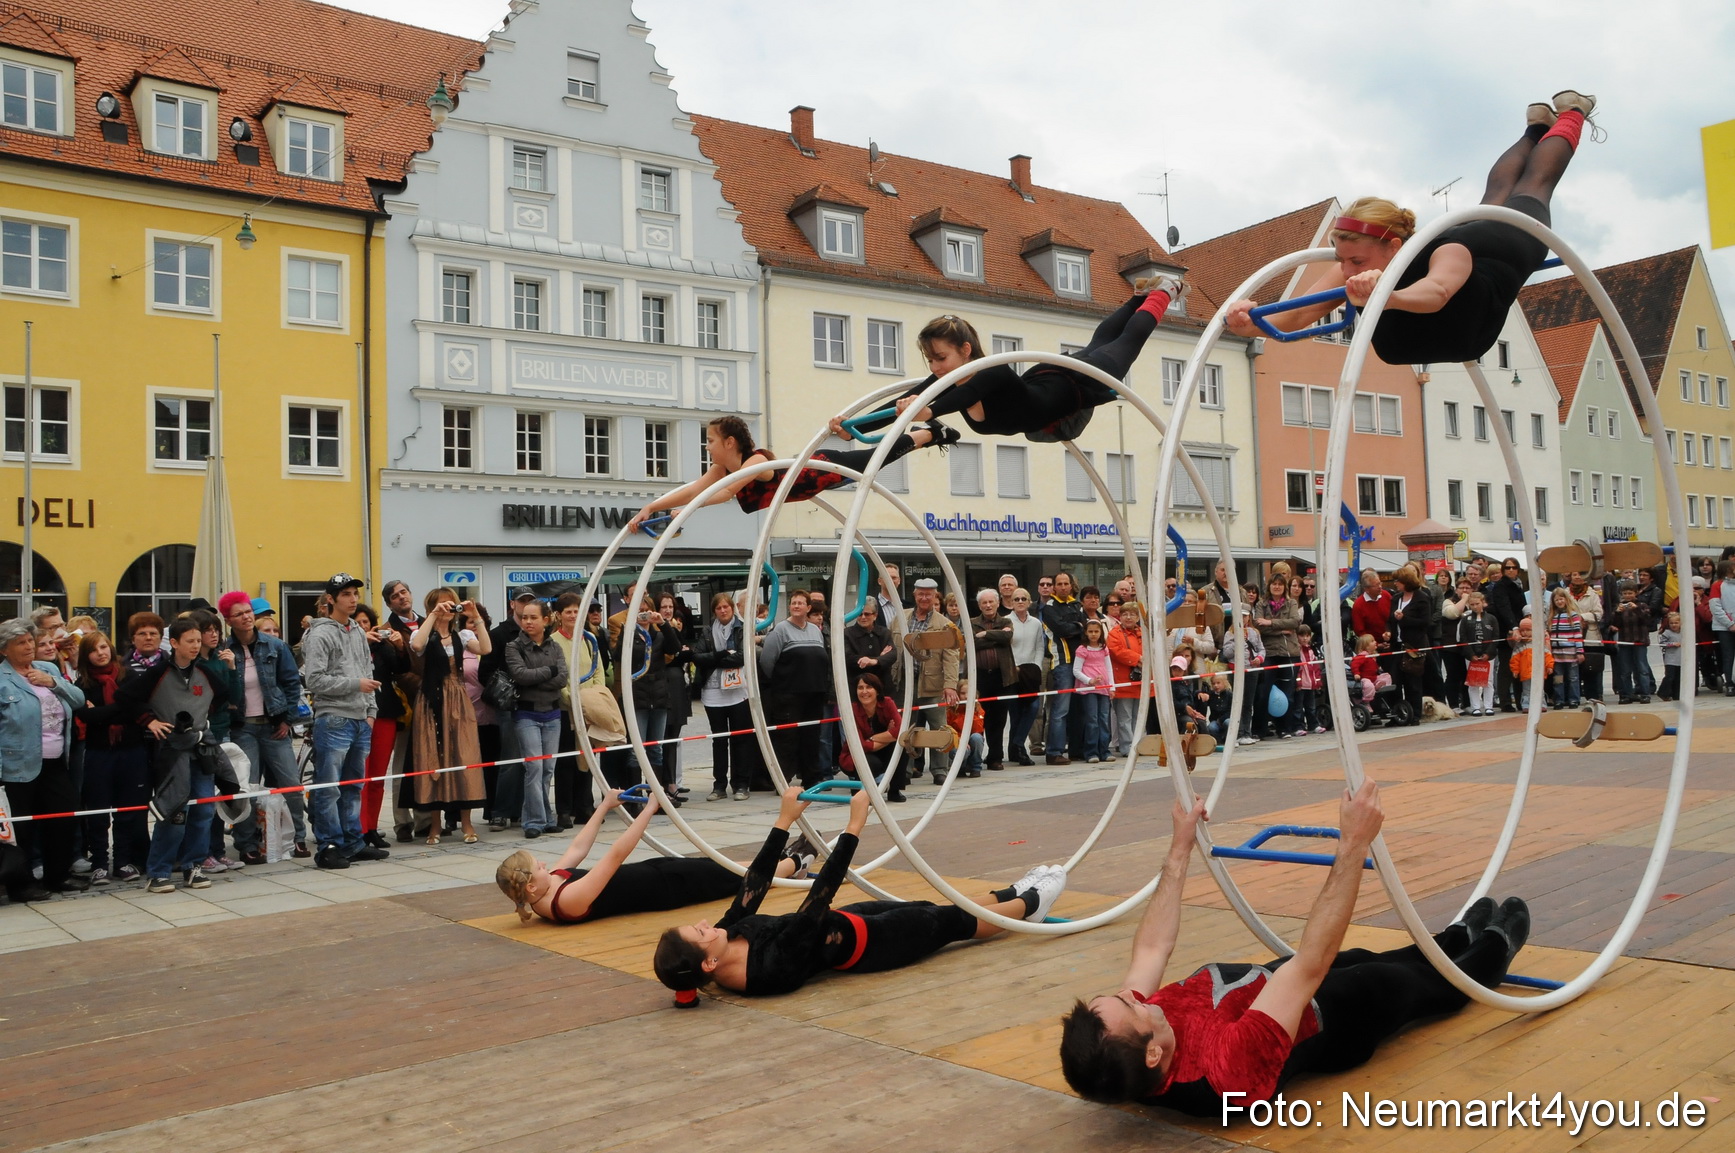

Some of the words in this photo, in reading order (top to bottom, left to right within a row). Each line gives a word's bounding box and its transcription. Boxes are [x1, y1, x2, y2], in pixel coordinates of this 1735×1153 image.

[521, 359, 597, 384] BRILLEN
[601, 366, 669, 390] WEBER
[18, 497, 94, 528] DELI
[503, 503, 595, 529] BRILLEN
[925, 512, 1048, 539] Buchhandlung
[512, 571, 548, 583] BRILLEN
[912, 566, 941, 576] Rupprecht
[728, 673, 736, 681] M
